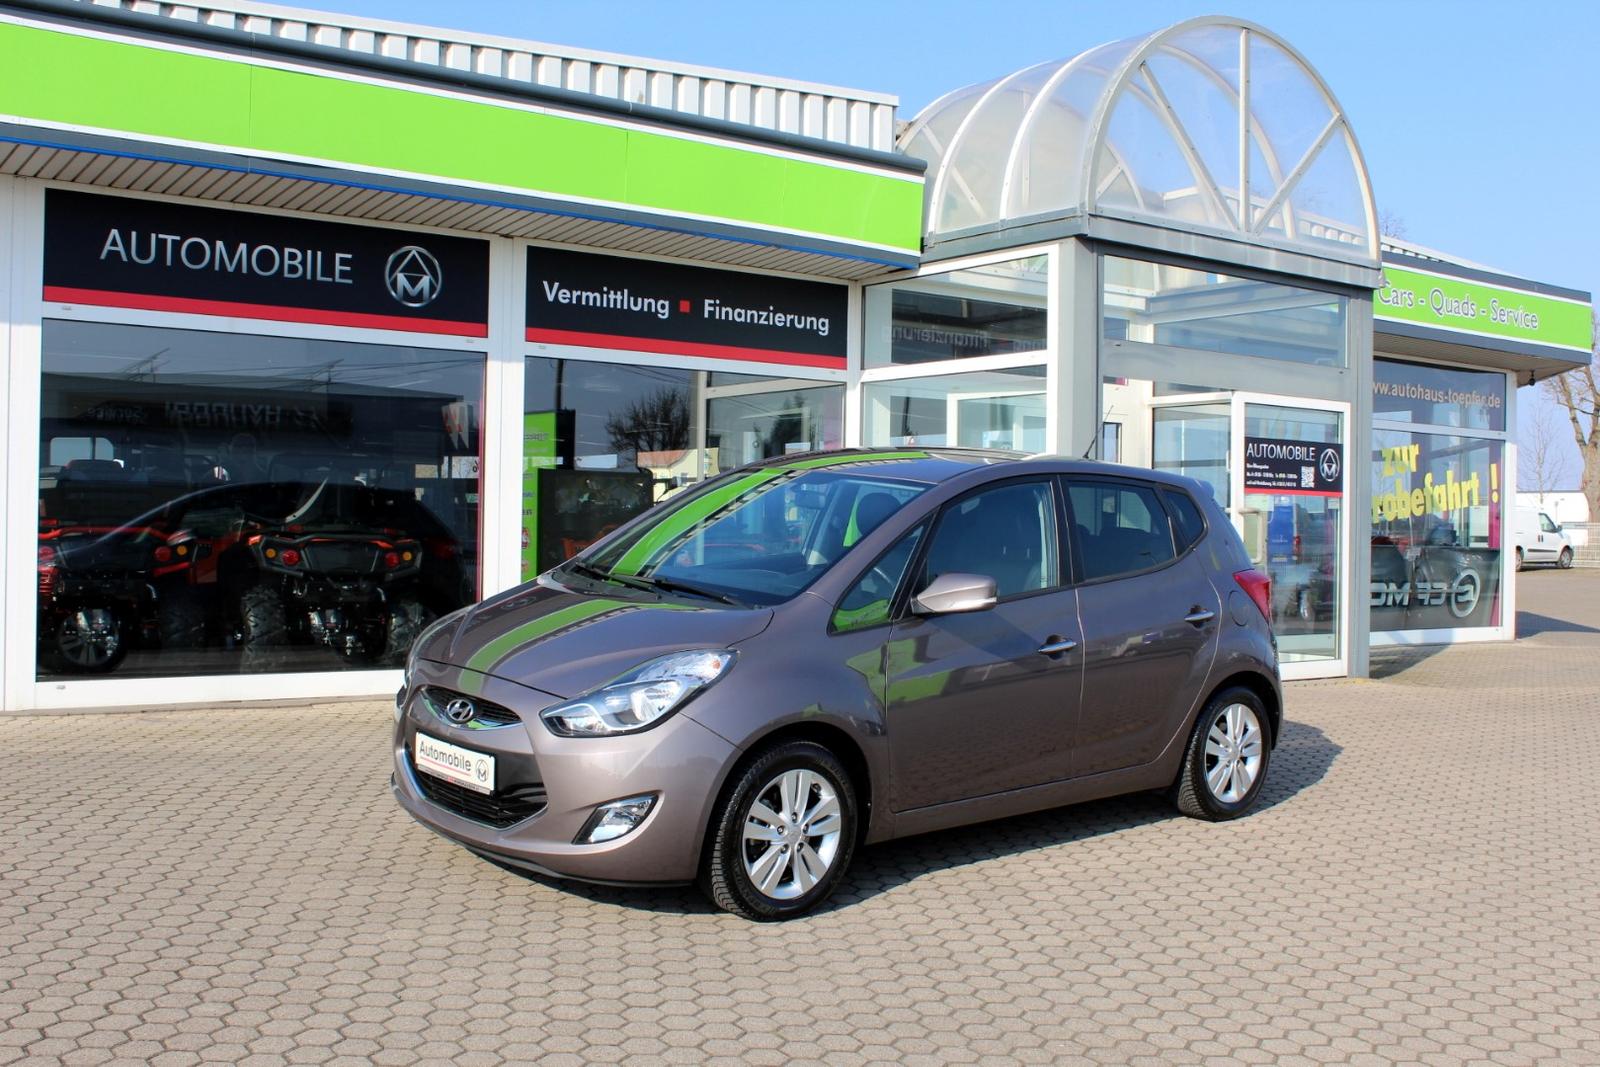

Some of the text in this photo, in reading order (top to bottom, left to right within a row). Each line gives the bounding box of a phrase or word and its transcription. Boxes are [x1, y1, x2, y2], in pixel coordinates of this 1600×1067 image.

[100, 228, 354, 285] AUTOMOBILE
[543, 280, 830, 336] Vermittlung Finanzierung
[1378, 280, 1414, 307] Cars
[1430, 287, 1476, 317] Quads
[1490, 299, 1539, 329] Service
[1246, 443, 1316, 462] AUTOMOBILE
[1381, 443, 1420, 477] zur
[1372, 469, 1480, 524] robefahrt
[419, 741, 472, 771] Automobile
